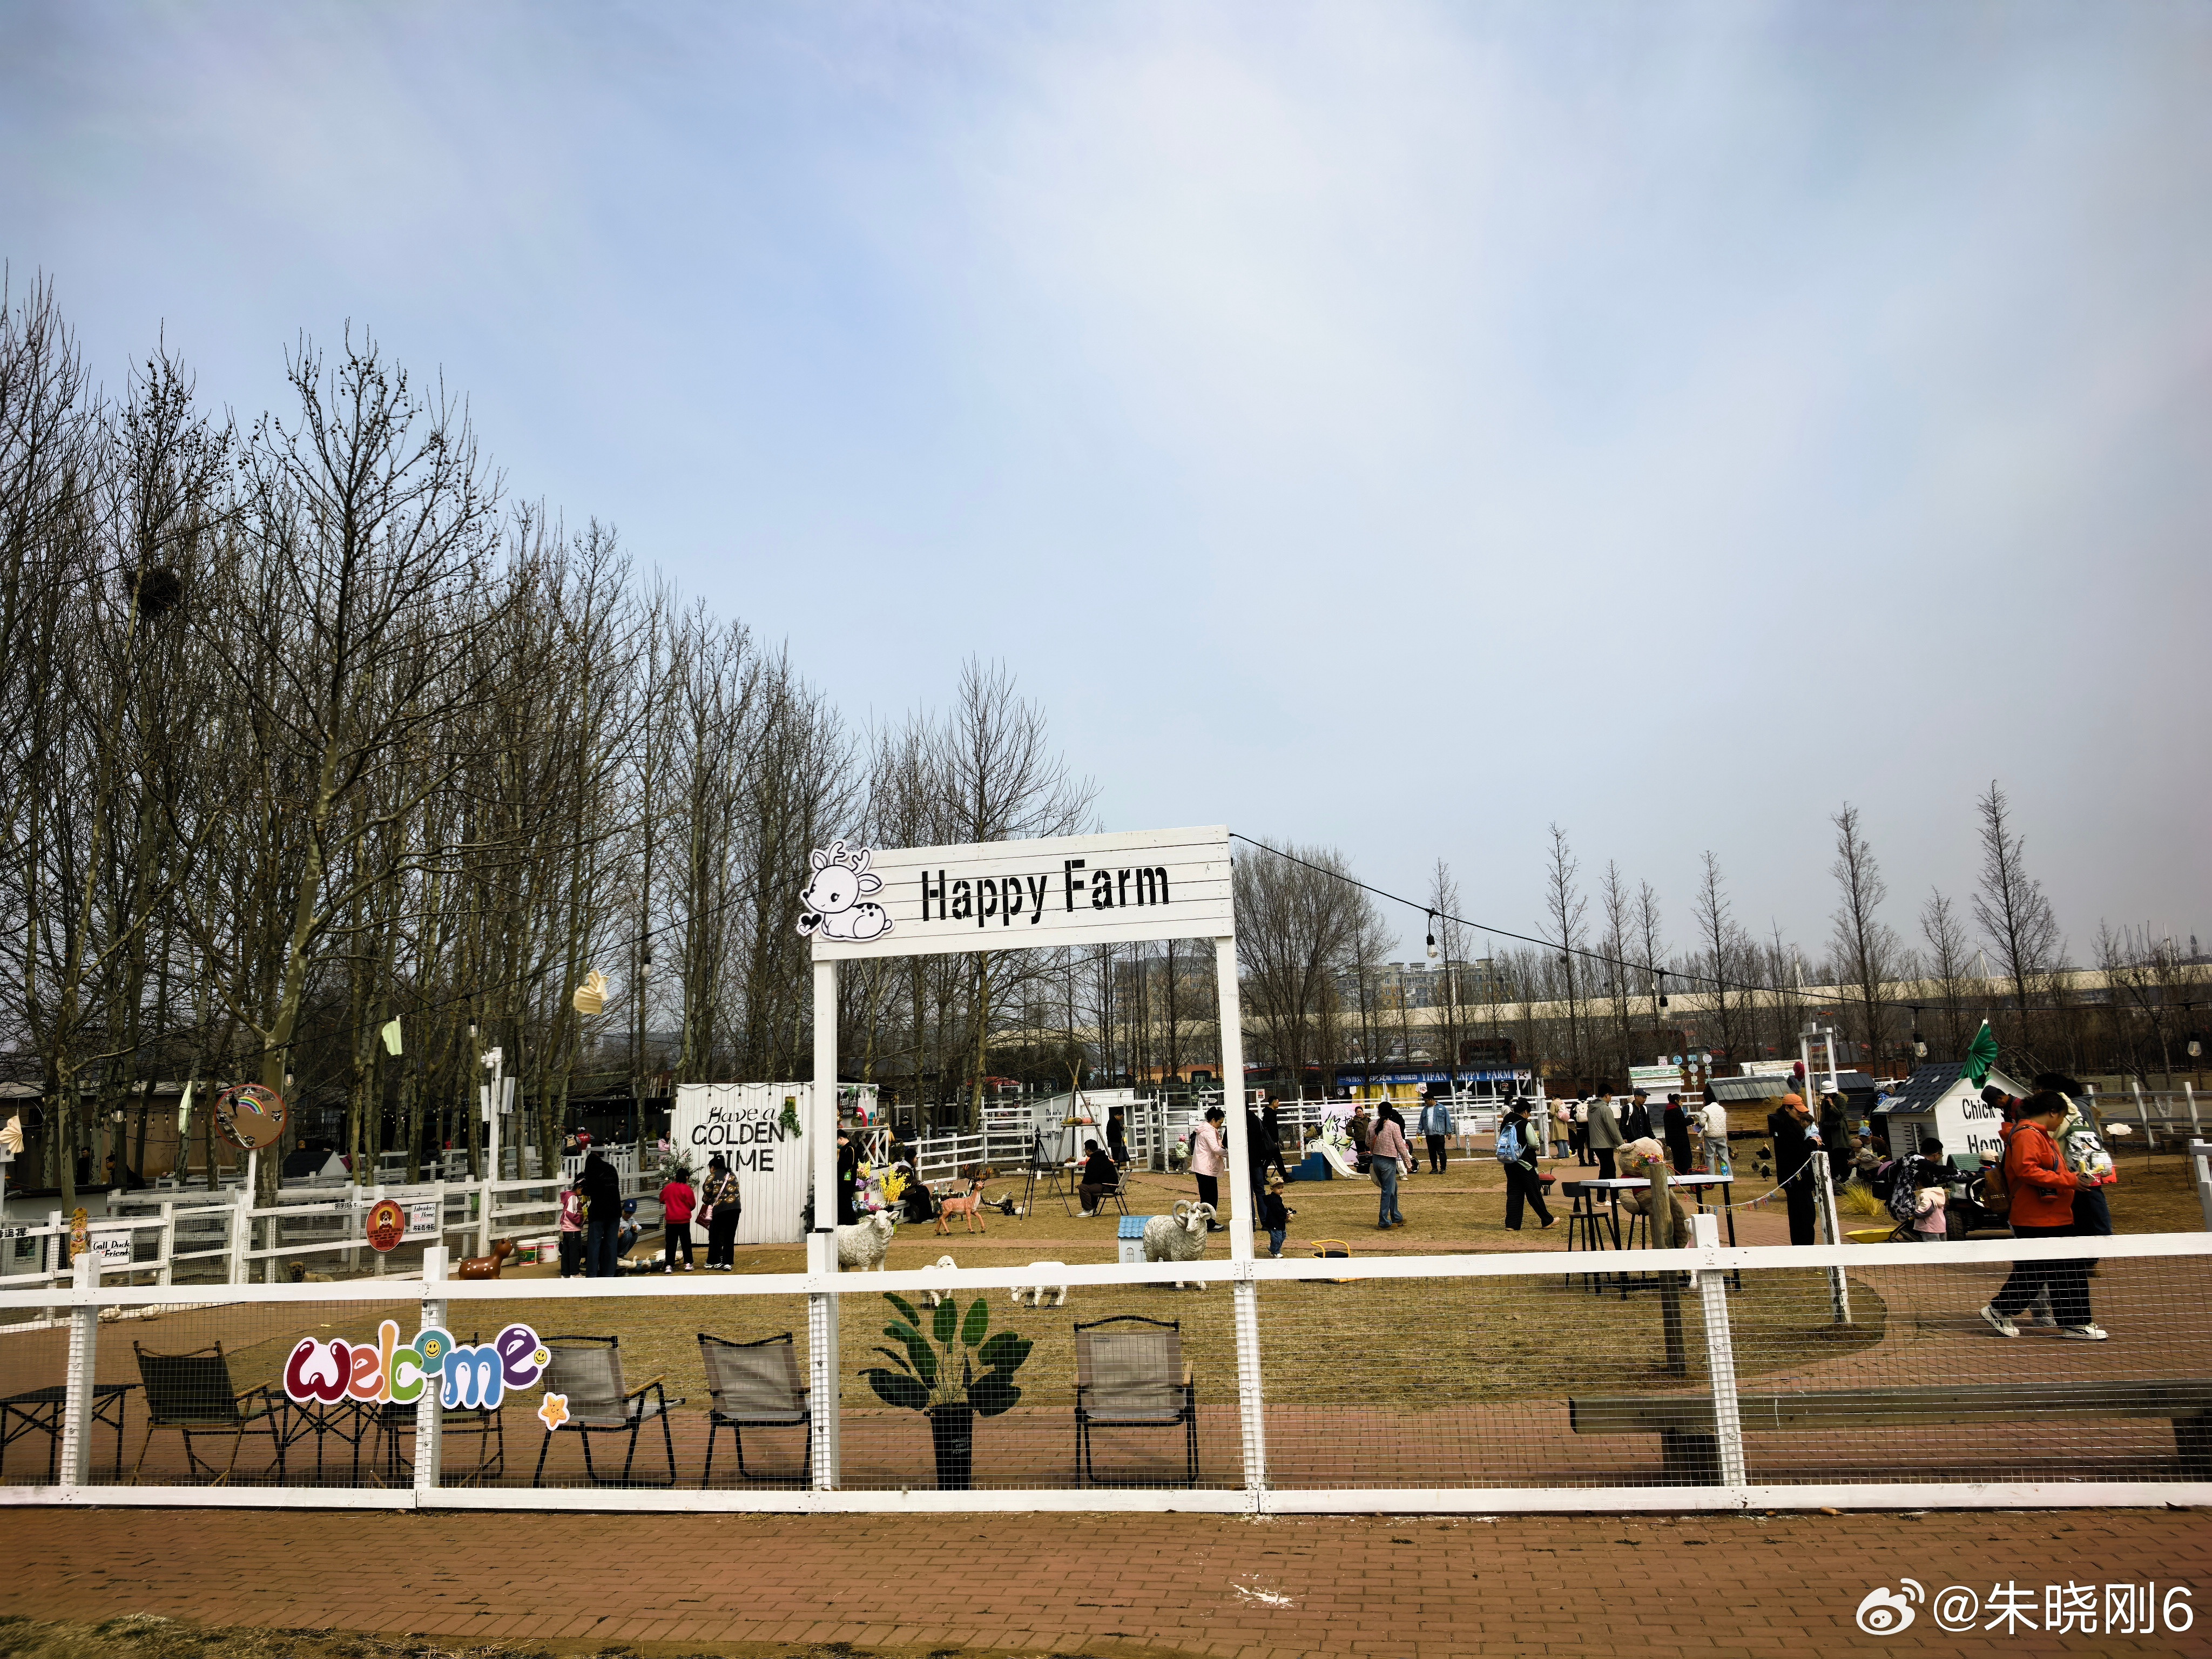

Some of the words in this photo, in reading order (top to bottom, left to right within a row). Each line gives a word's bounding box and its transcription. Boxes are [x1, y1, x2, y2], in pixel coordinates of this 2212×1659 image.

[921, 869, 1048, 928] Happy
[1064, 859, 1169, 913] Farm
[1421, 1071, 1447, 1081] YIFAN
[1456, 1070, 1480, 1080] APPY
[1486, 1069, 1511, 1080] FARM
[703, 1107, 758, 1124] Have
[762, 1108, 777, 1121] a
[1962, 1098, 2004, 1120] Chick
[692, 1121, 785, 1145] GOLDEN
[1967, 1134, 2003, 1154] Hom
[708, 1149, 774, 1172] TIME
[111, 1239, 130, 1249] Duck
[285, 1321, 547, 1407] welcome
